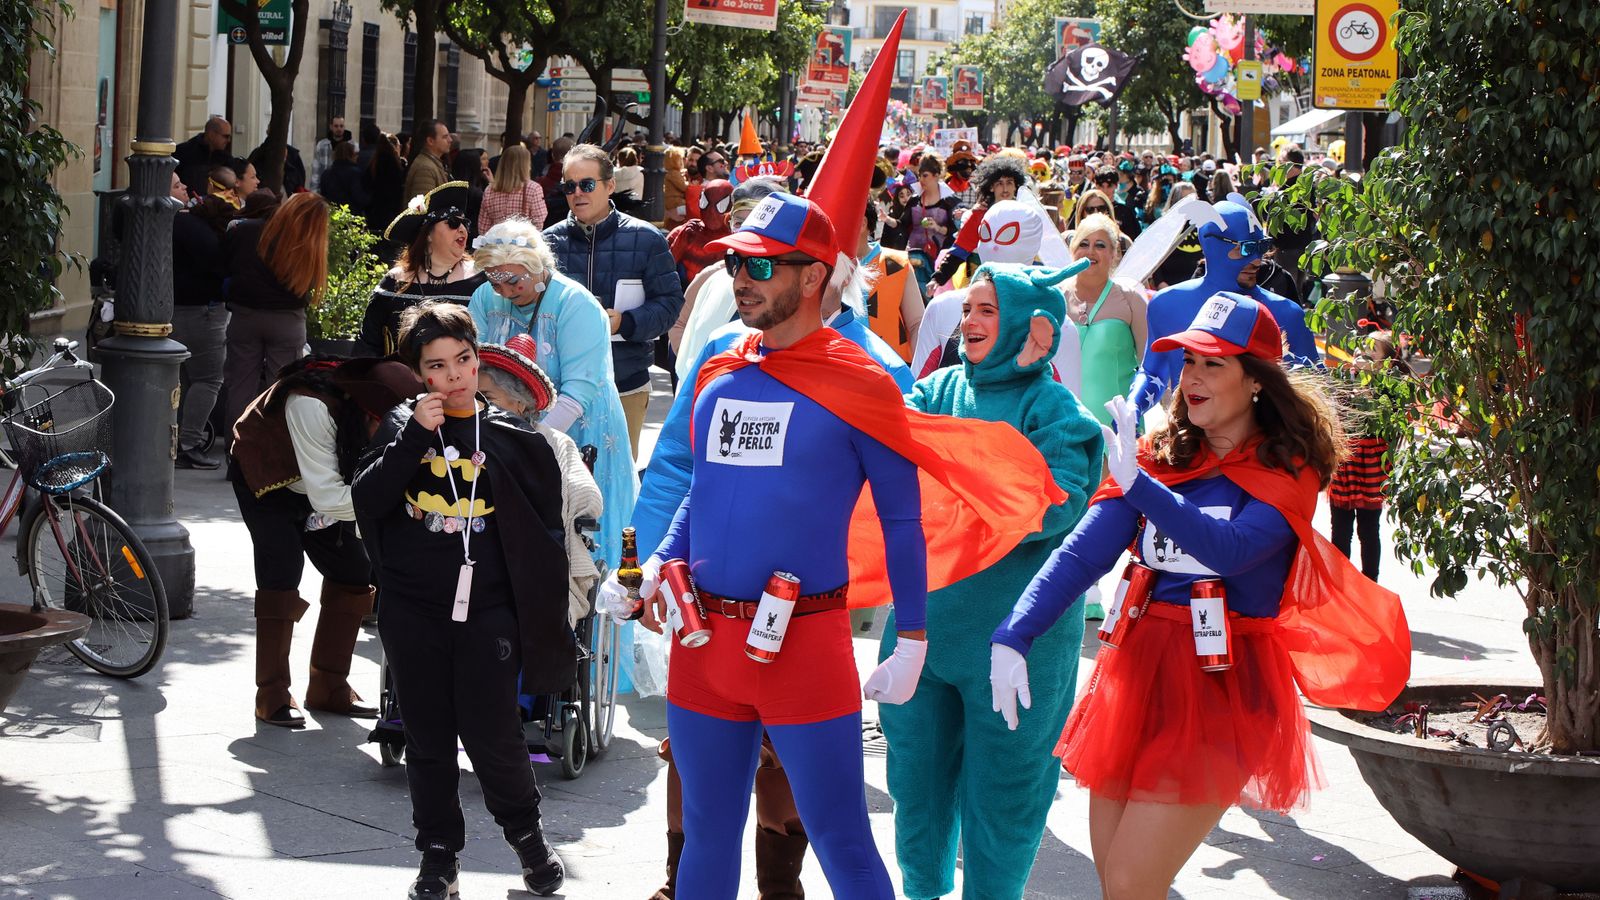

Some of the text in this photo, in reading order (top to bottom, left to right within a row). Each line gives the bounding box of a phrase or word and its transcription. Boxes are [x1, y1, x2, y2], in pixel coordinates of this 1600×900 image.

[738, 0, 765, 10] Jerez
[261, 32, 284, 40] viRed
[1321, 67, 1391, 78] ZONA PEATONAL
[740, 422, 780, 435] DESTRA
[738, 436, 773, 450] PERLO.
